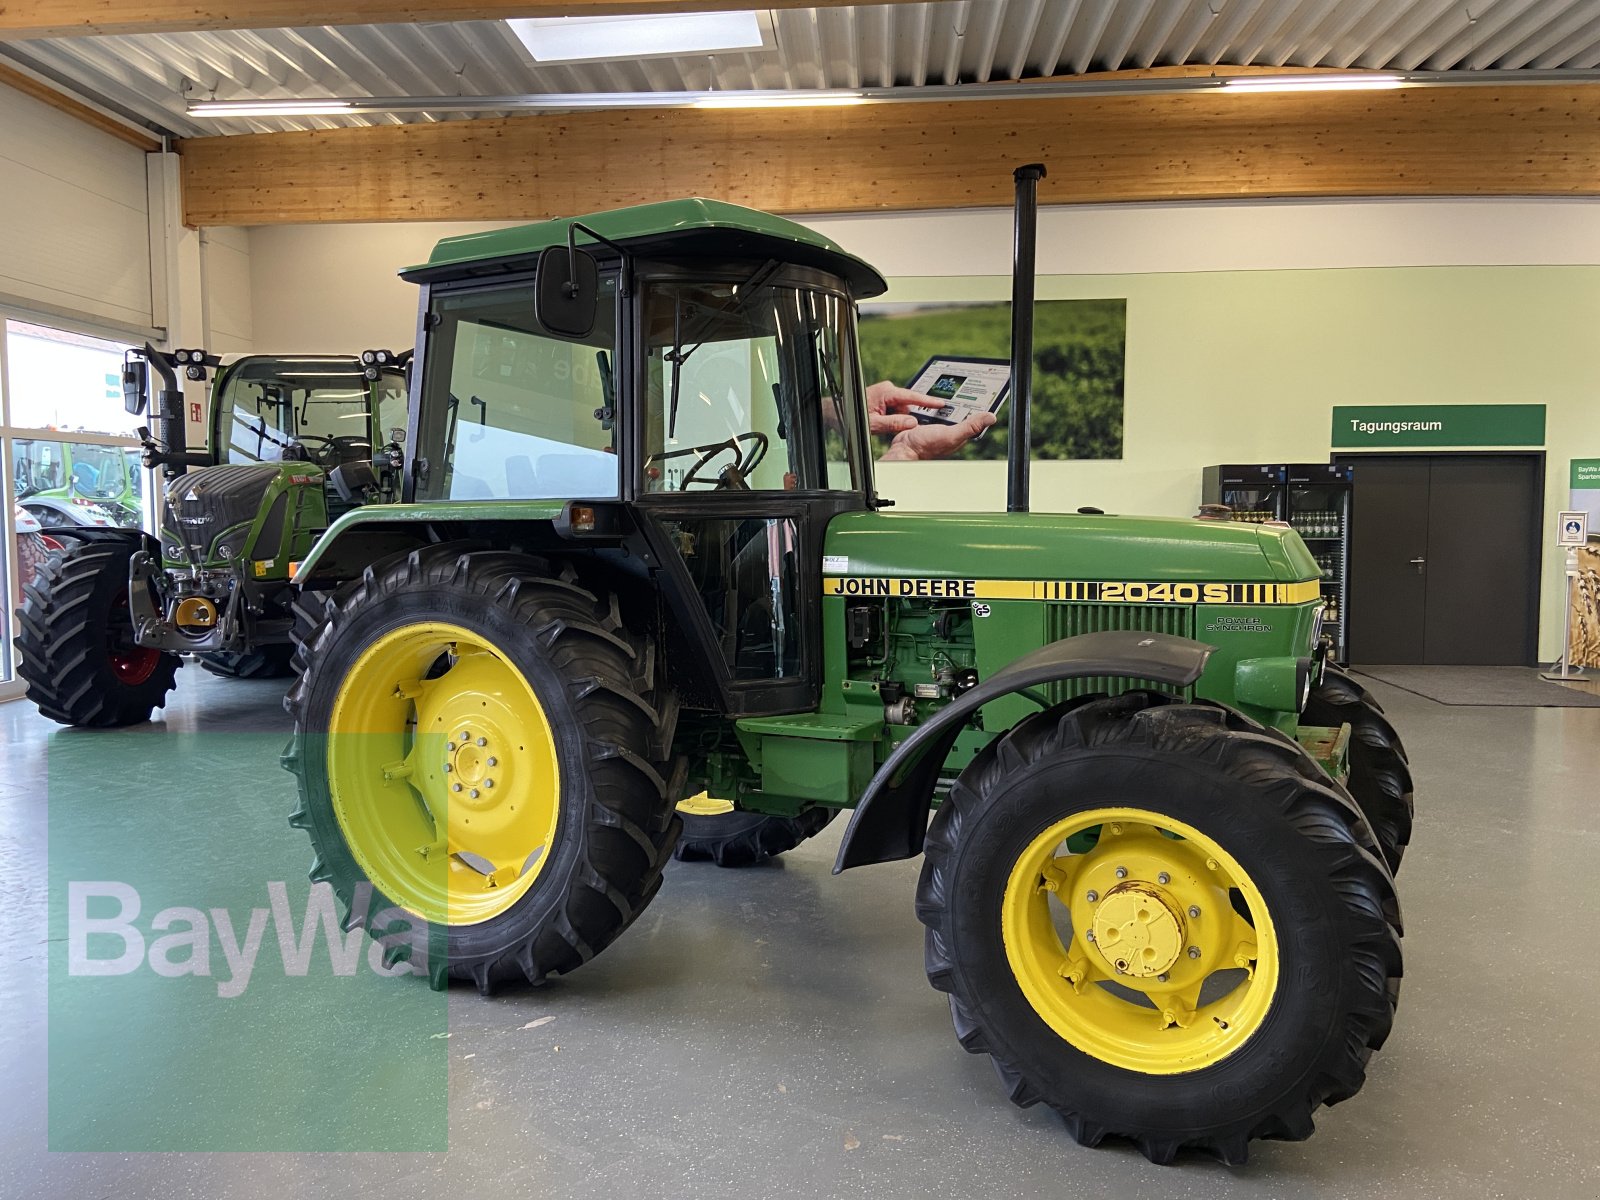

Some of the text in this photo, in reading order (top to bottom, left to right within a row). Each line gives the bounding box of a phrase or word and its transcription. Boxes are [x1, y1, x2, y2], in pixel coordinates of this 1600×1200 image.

[1351, 419, 1442, 434] Tagungsraum
[834, 578, 976, 597] JOHN DEERE
[1101, 582, 1229, 603] 2040 S
[976, 604, 990, 616] GS
[1217, 617, 1261, 625] POWER
[1205, 624, 1272, 632] SYNCHRON
